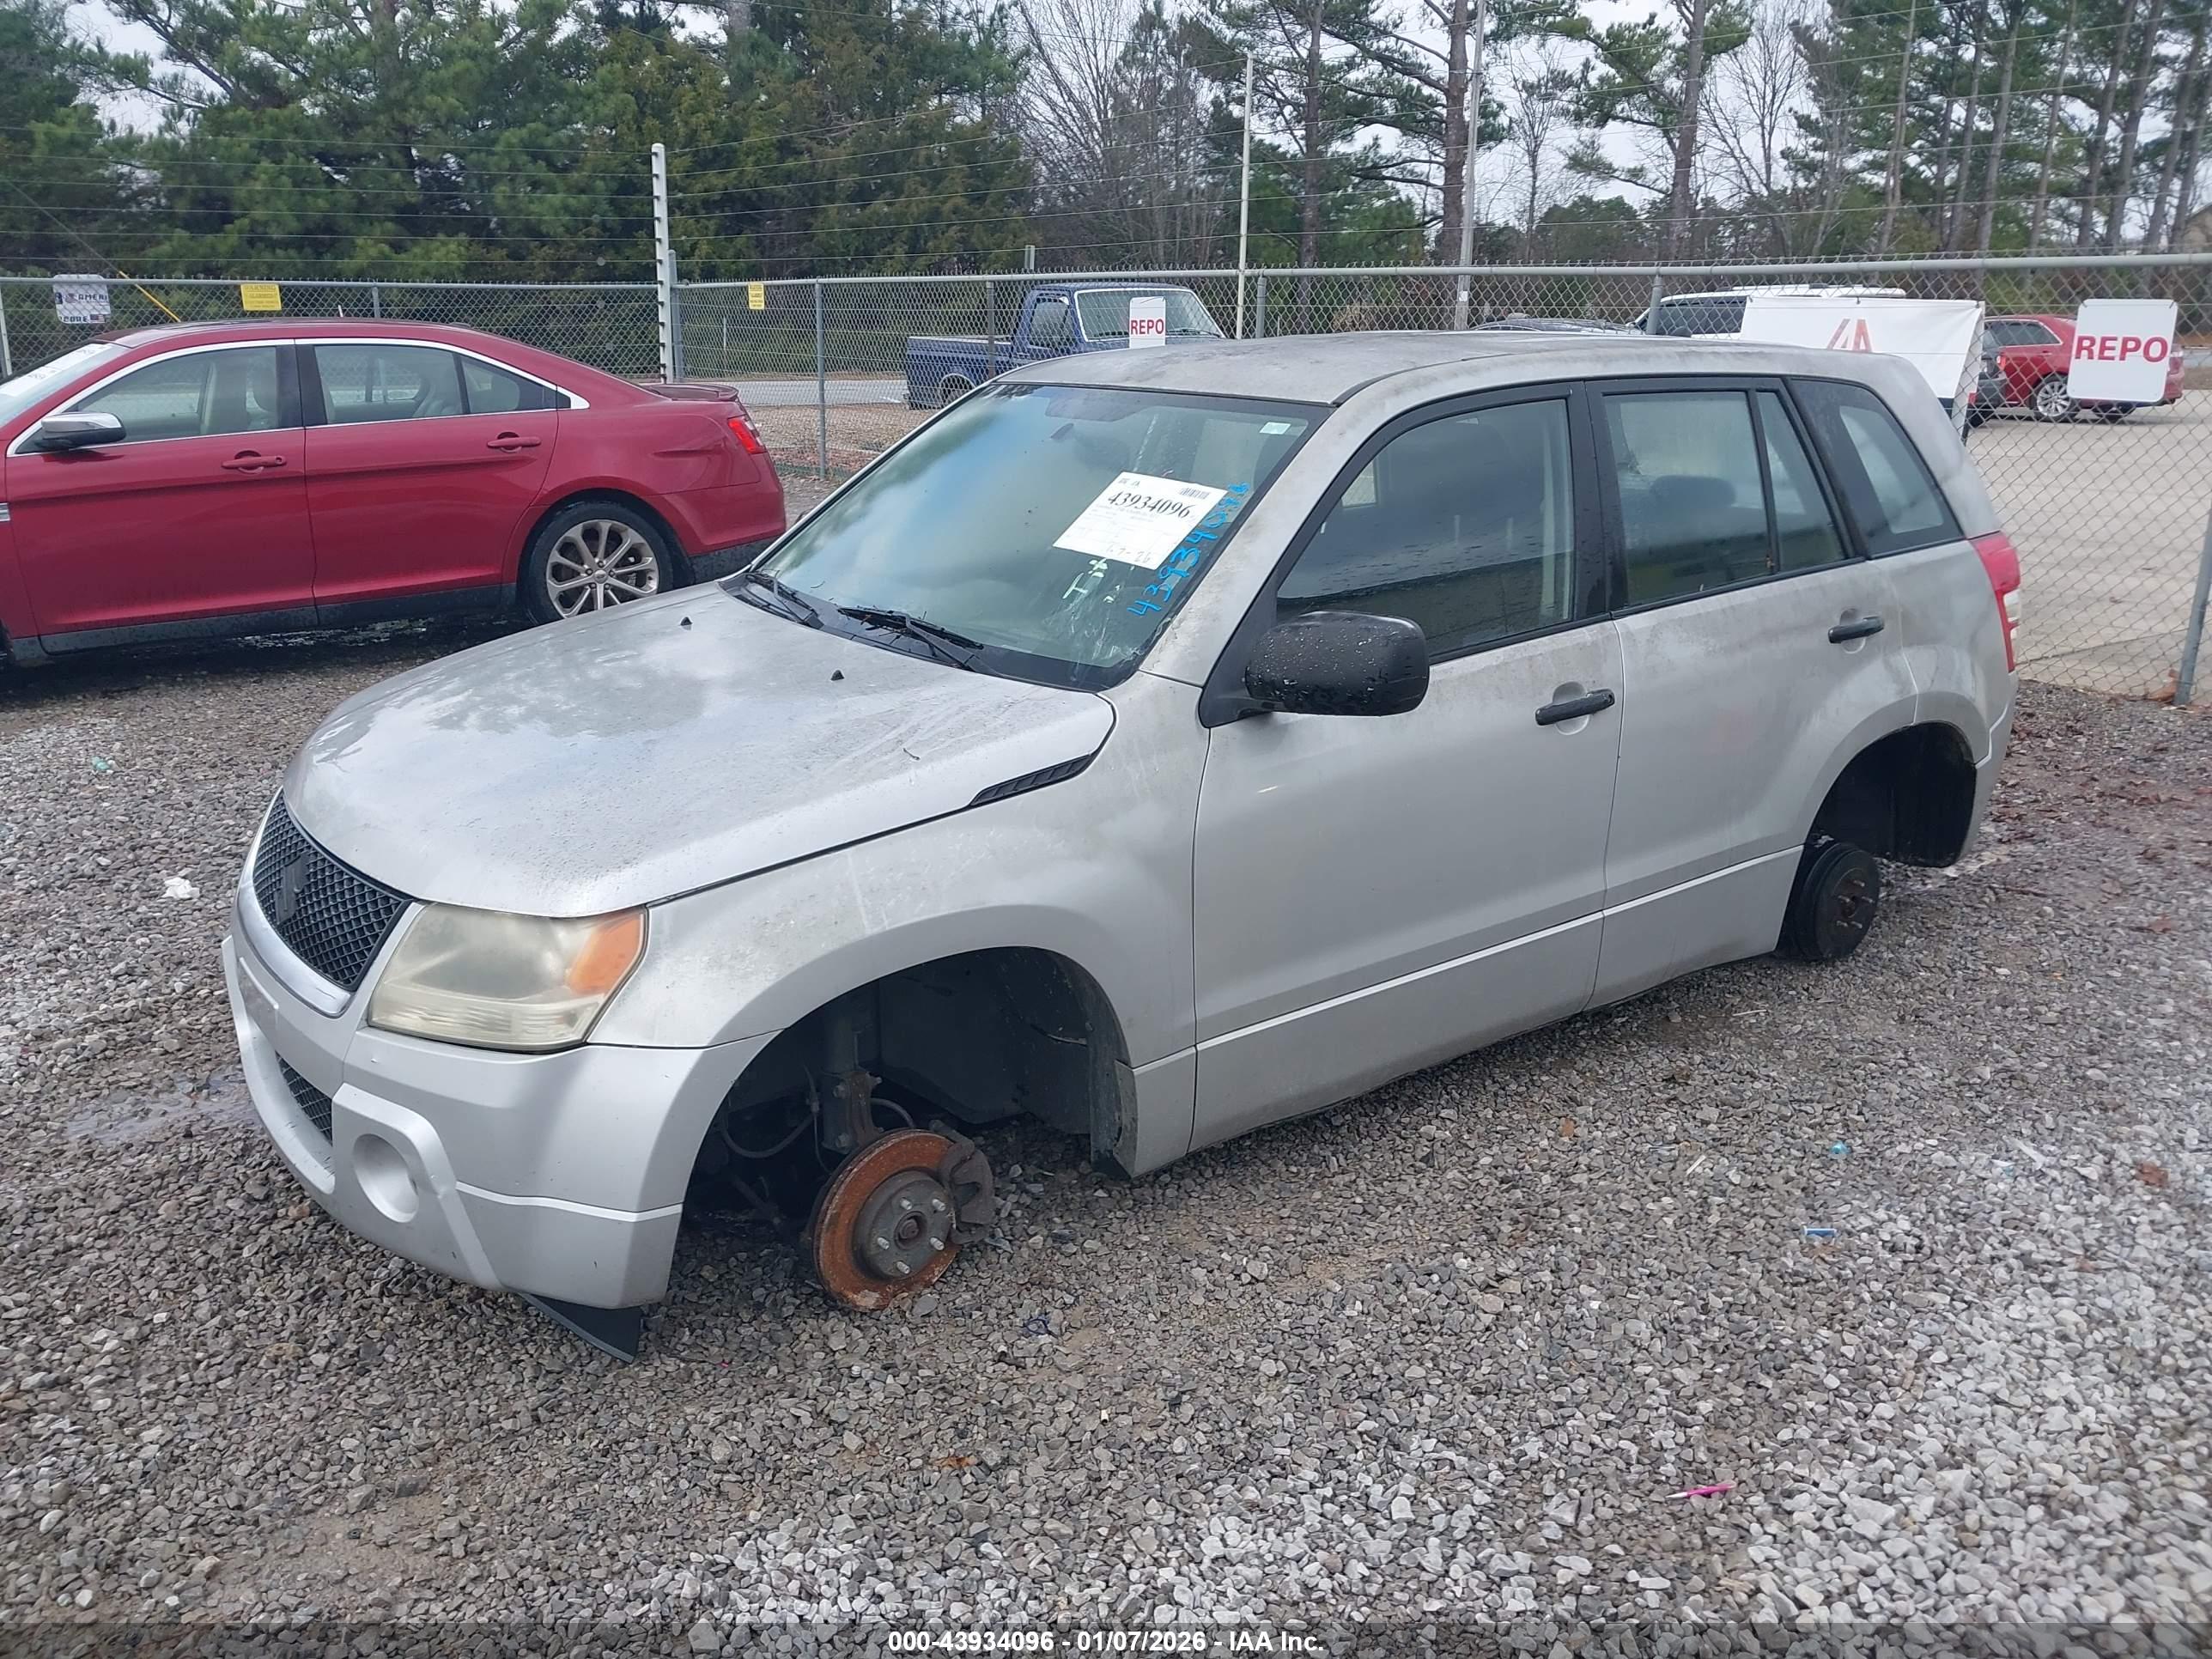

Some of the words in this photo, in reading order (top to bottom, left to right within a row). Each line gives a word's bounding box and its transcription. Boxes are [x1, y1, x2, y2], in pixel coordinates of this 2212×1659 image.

[1130, 318, 1164, 335] REPO
[2075, 335, 2169, 362] REPO
[1108, 490, 1196, 519] 43934096
